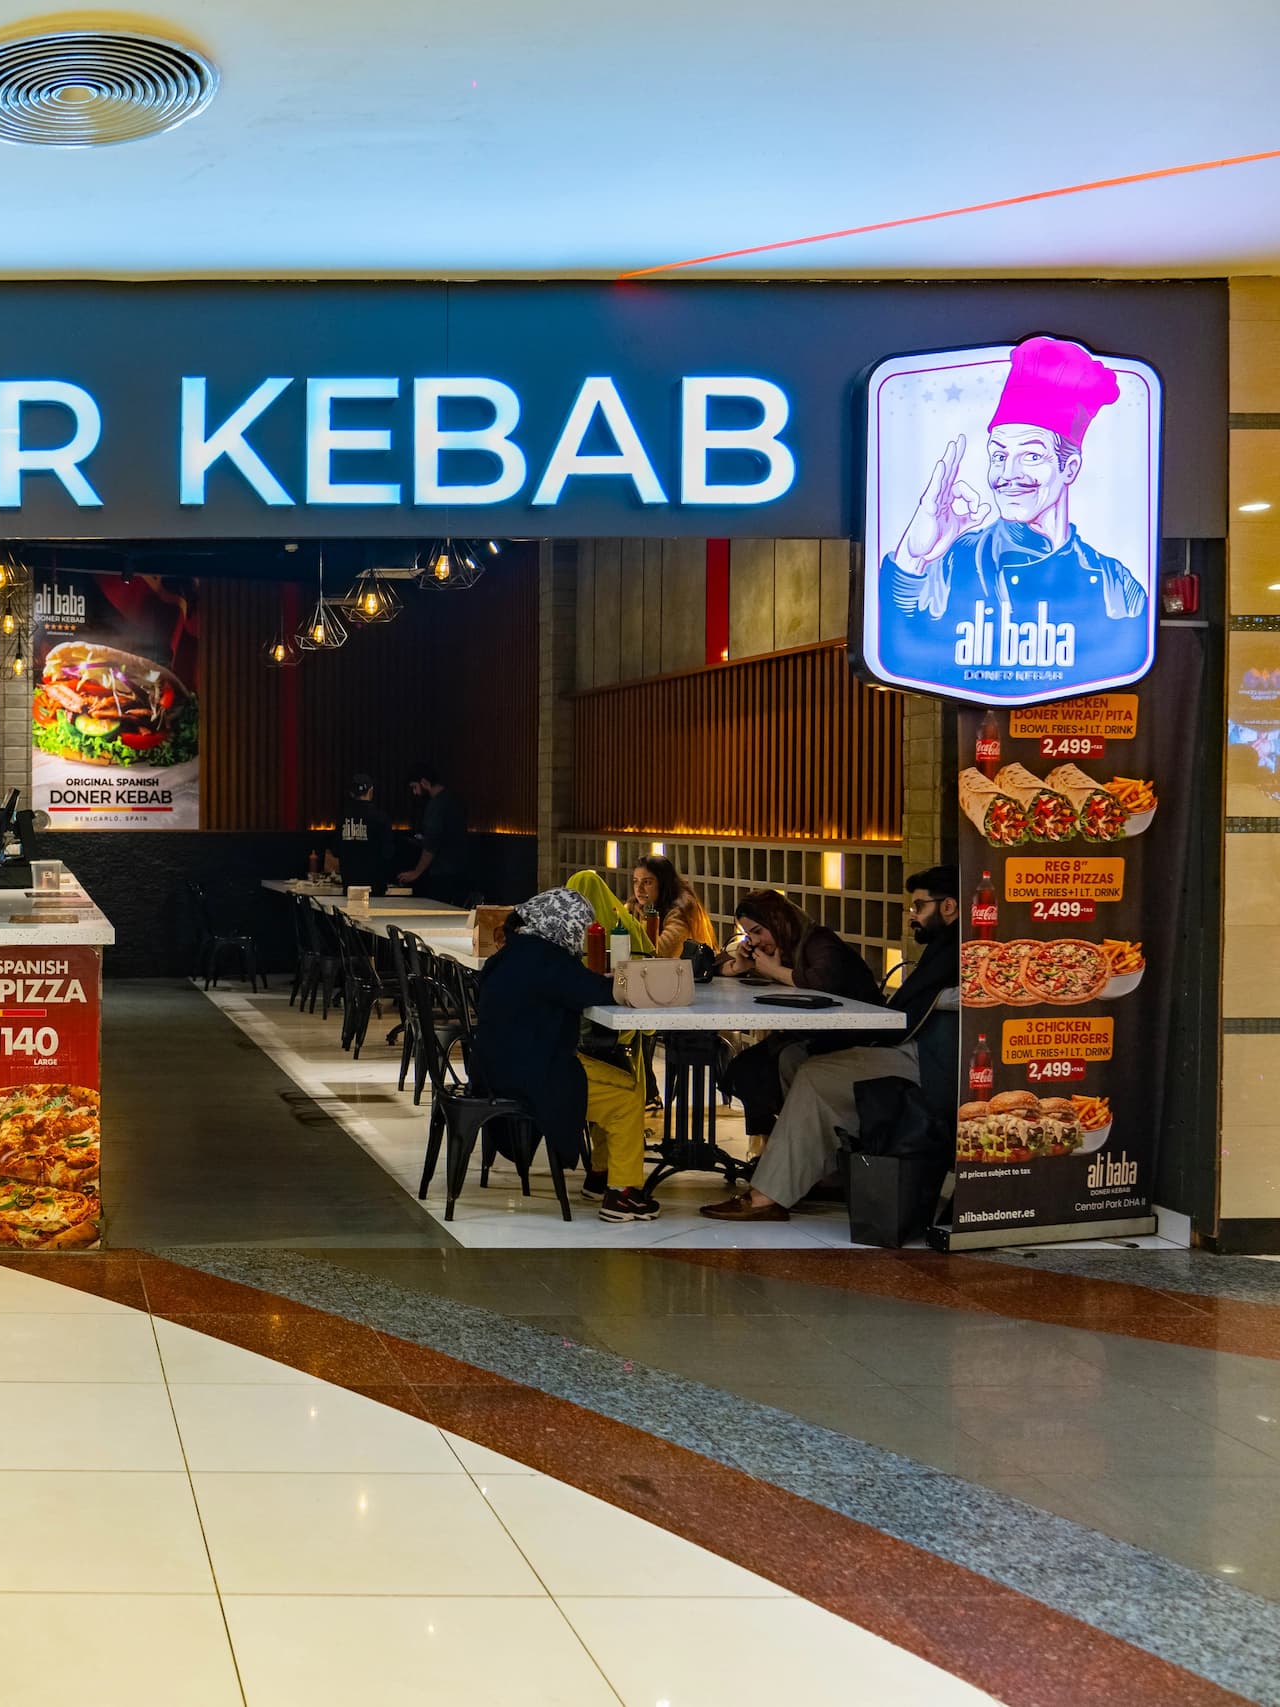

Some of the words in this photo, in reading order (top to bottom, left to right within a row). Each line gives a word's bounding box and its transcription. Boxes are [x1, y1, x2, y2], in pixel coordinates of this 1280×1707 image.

[179, 375, 797, 506] KEBAB
[964, 670, 1014, 681] DONER
[1014, 710, 1058, 721] DONER
[1106, 710, 1133, 721] PITA
[1020, 724, 1050, 733] BOWL
[1105, 725, 1133, 734] DRINK
[1043, 739, 1091, 756] 2,499
[66, 778, 115, 787] ORIGINAL
[116, 778, 159, 787] SPANISH
[49, 790, 111, 804] DONER
[115, 790, 173, 804] KEBAB
[1045, 861, 1070, 872] REG
[1016, 873, 1023, 884] 3
[1024, 873, 1070, 884] DONER
[1072, 873, 1114, 884] PIZZAS
[1013, 888, 1040, 897] BOWL
[1095, 888, 1120, 897] DRINK
[1034, 902, 1081, 920] 2,499
[1026, 1022, 1033, 1033] 3
[1035, 1022, 1091, 1033] CHICKEN
[1009, 1034, 1052, 1046] GRILLED
[1054, 1033, 1109, 1045] BURGERS
[1011, 1049, 1035, 1059] BOWL
[1086, 1047, 1111, 1057] DRINK
[33, 1058, 58, 1066] LARGE
[1029, 1062, 1071, 1081] 2,499
[968, 1170, 987, 1179] prices
[988, 1169, 1011, 1177] subject
[1075, 1201, 1105, 1211] Central
[1105, 1200, 1123, 1209] Park
[1124, 1198, 1140, 1207] DHA
[959, 1209, 1035, 1224] alibabadoner.es
